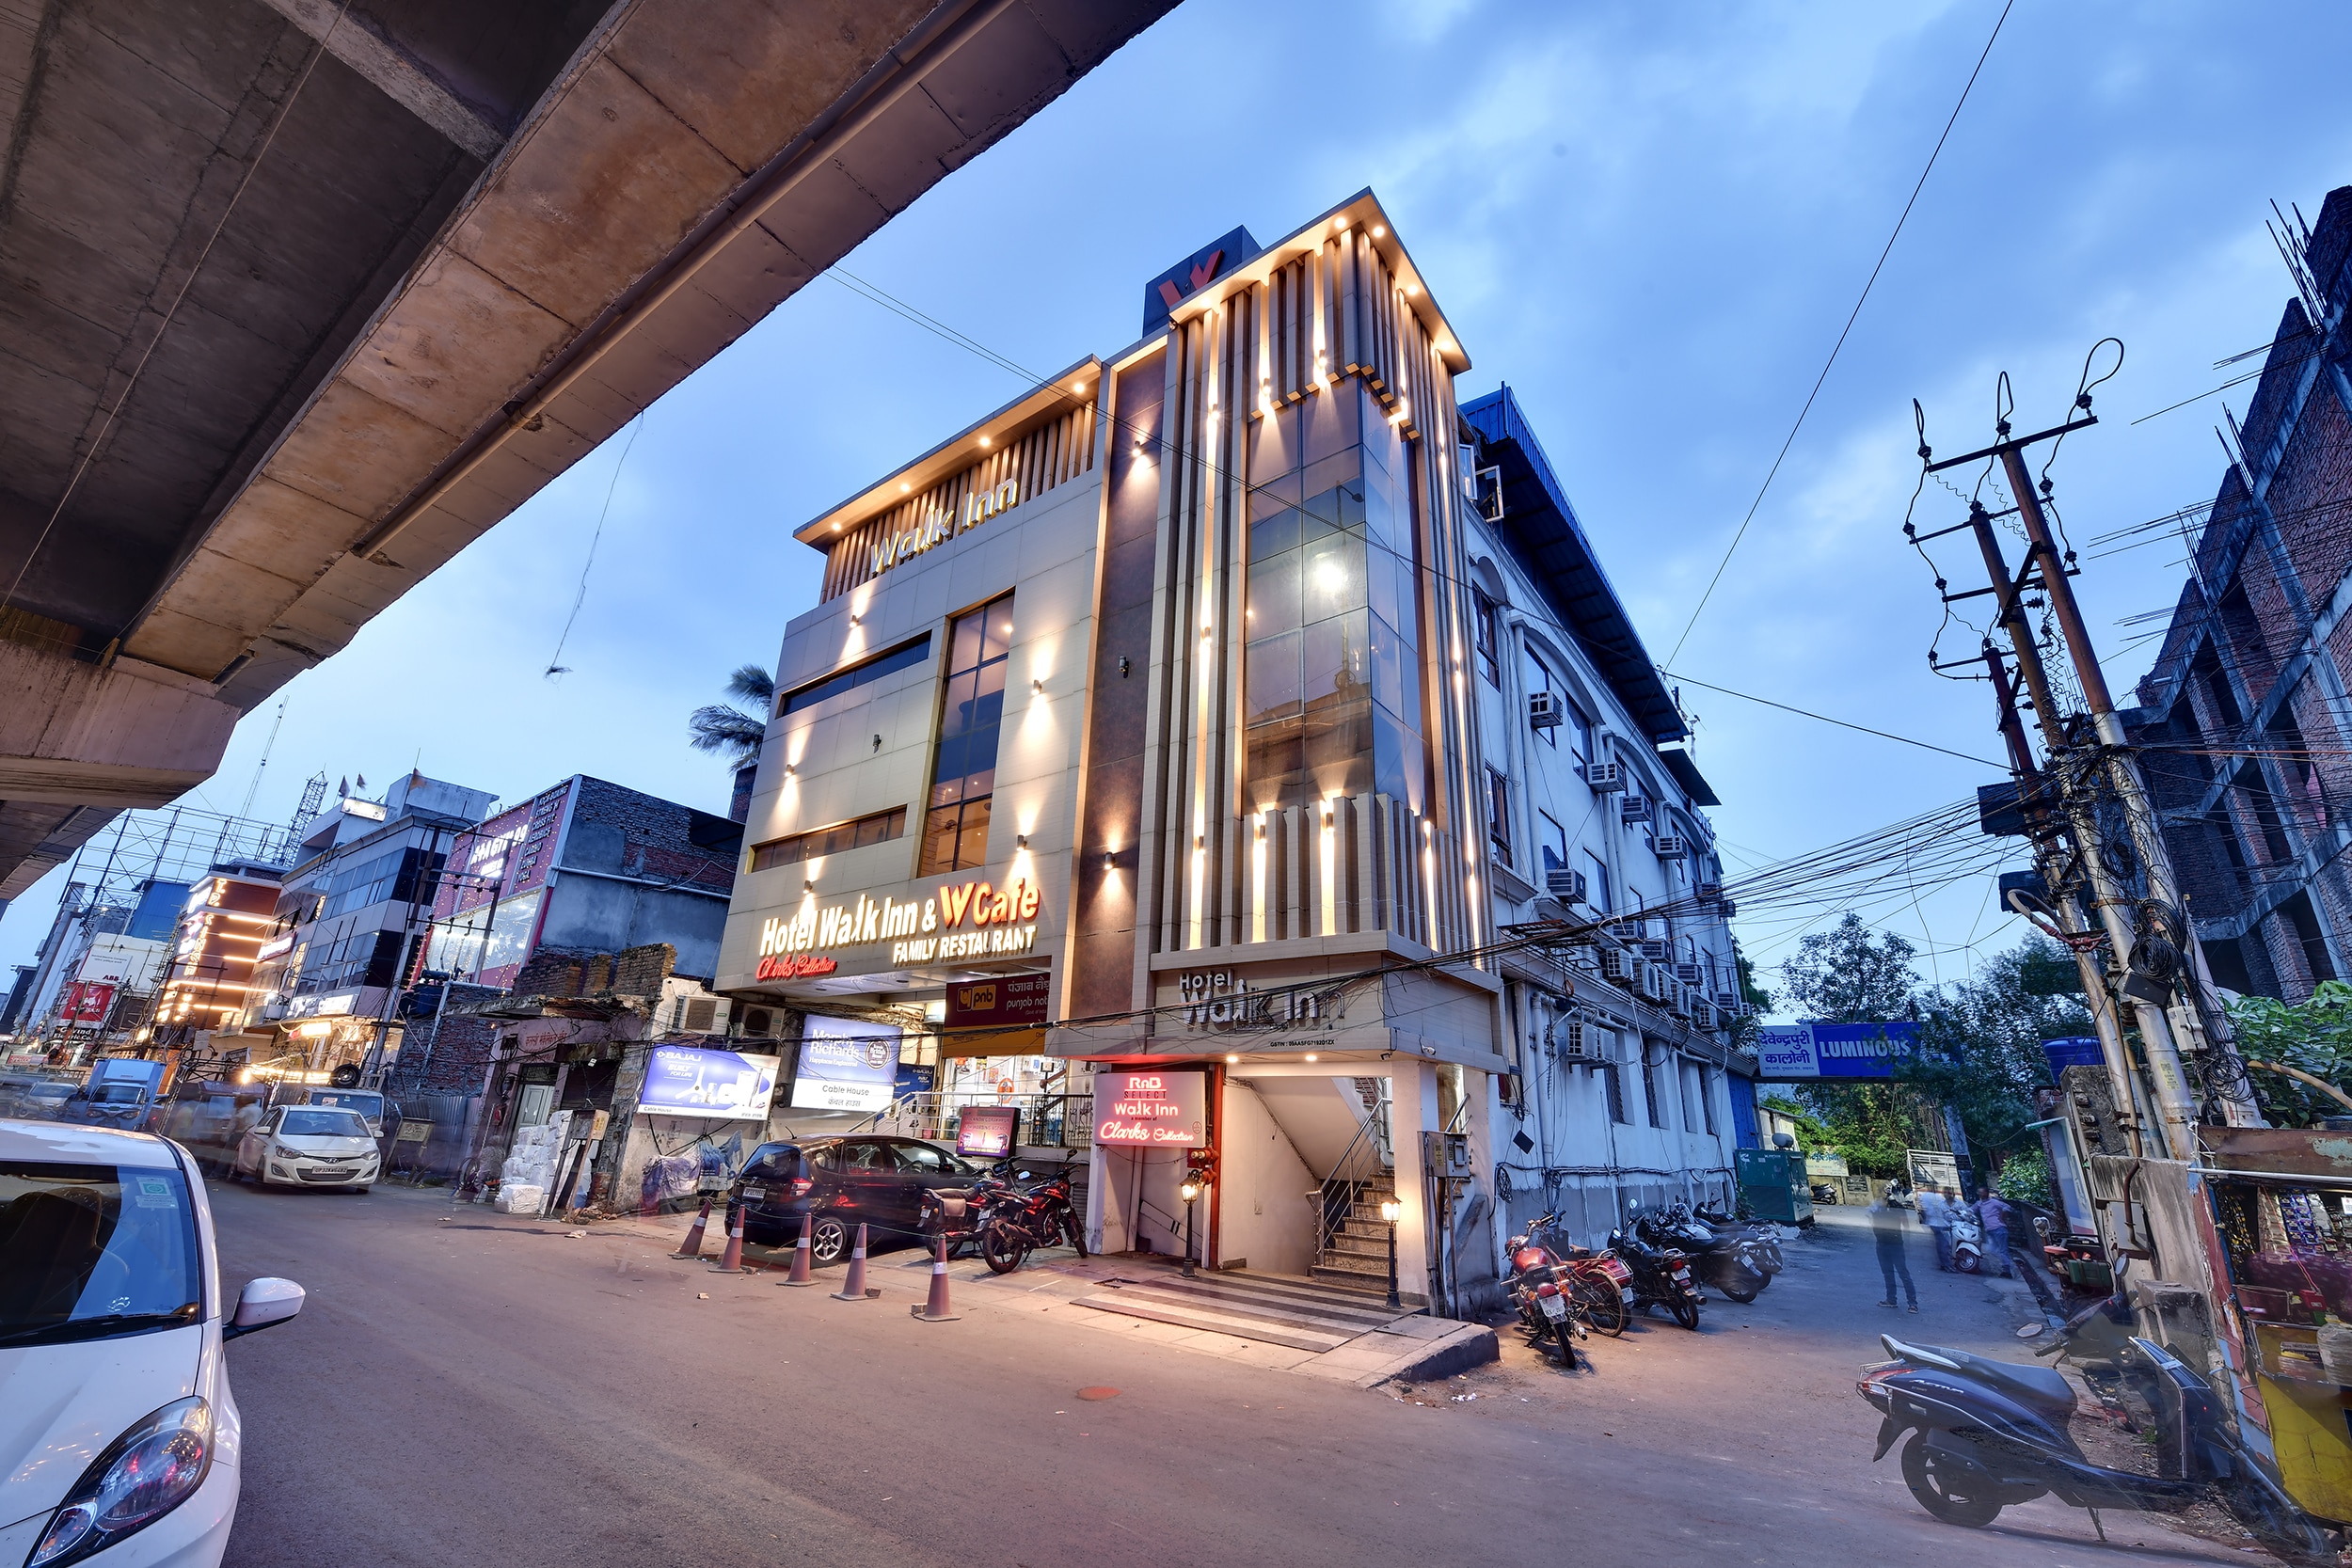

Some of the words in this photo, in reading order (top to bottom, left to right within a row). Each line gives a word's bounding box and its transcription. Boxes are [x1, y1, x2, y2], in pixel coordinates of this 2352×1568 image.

[870, 504, 955, 576] Walk
[961, 478, 1018, 530] Inn
[759, 910, 820, 958] Hotel
[818, 893, 882, 949] Walk
[881, 896, 919, 940] Inn
[921, 898, 938, 933] &
[893, 938, 939, 965] FAMILY
[939, 925, 1038, 959] RESTAURANT
[1179, 968, 1234, 990] Hotel
[973, 988, 993, 1006] pnb
[1006, 996, 1033, 1011] punjab
[1179, 978, 1274, 1025] Walk
[1283, 990, 1345, 1021] Inn
[59, 1026, 92, 1035] Gvind
[665, 1051, 702, 1062] BAJAJ
[810, 1040, 861, 1058] Richards
[1764, 1050, 1811, 1064] कालोनी
[1819, 1038, 1912, 1058] LUMINOUS
[822, 1085, 845, 1094] Cable
[846, 1086, 869, 1096] House
[1123, 1090, 1167, 1100] SELECT
[1114, 1100, 1152, 1116] Walk
[1155, 1102, 1179, 1116] Inn
[1100, 1121, 1150, 1141] Clarks
[1152, 1128, 1195, 1142] Collection
